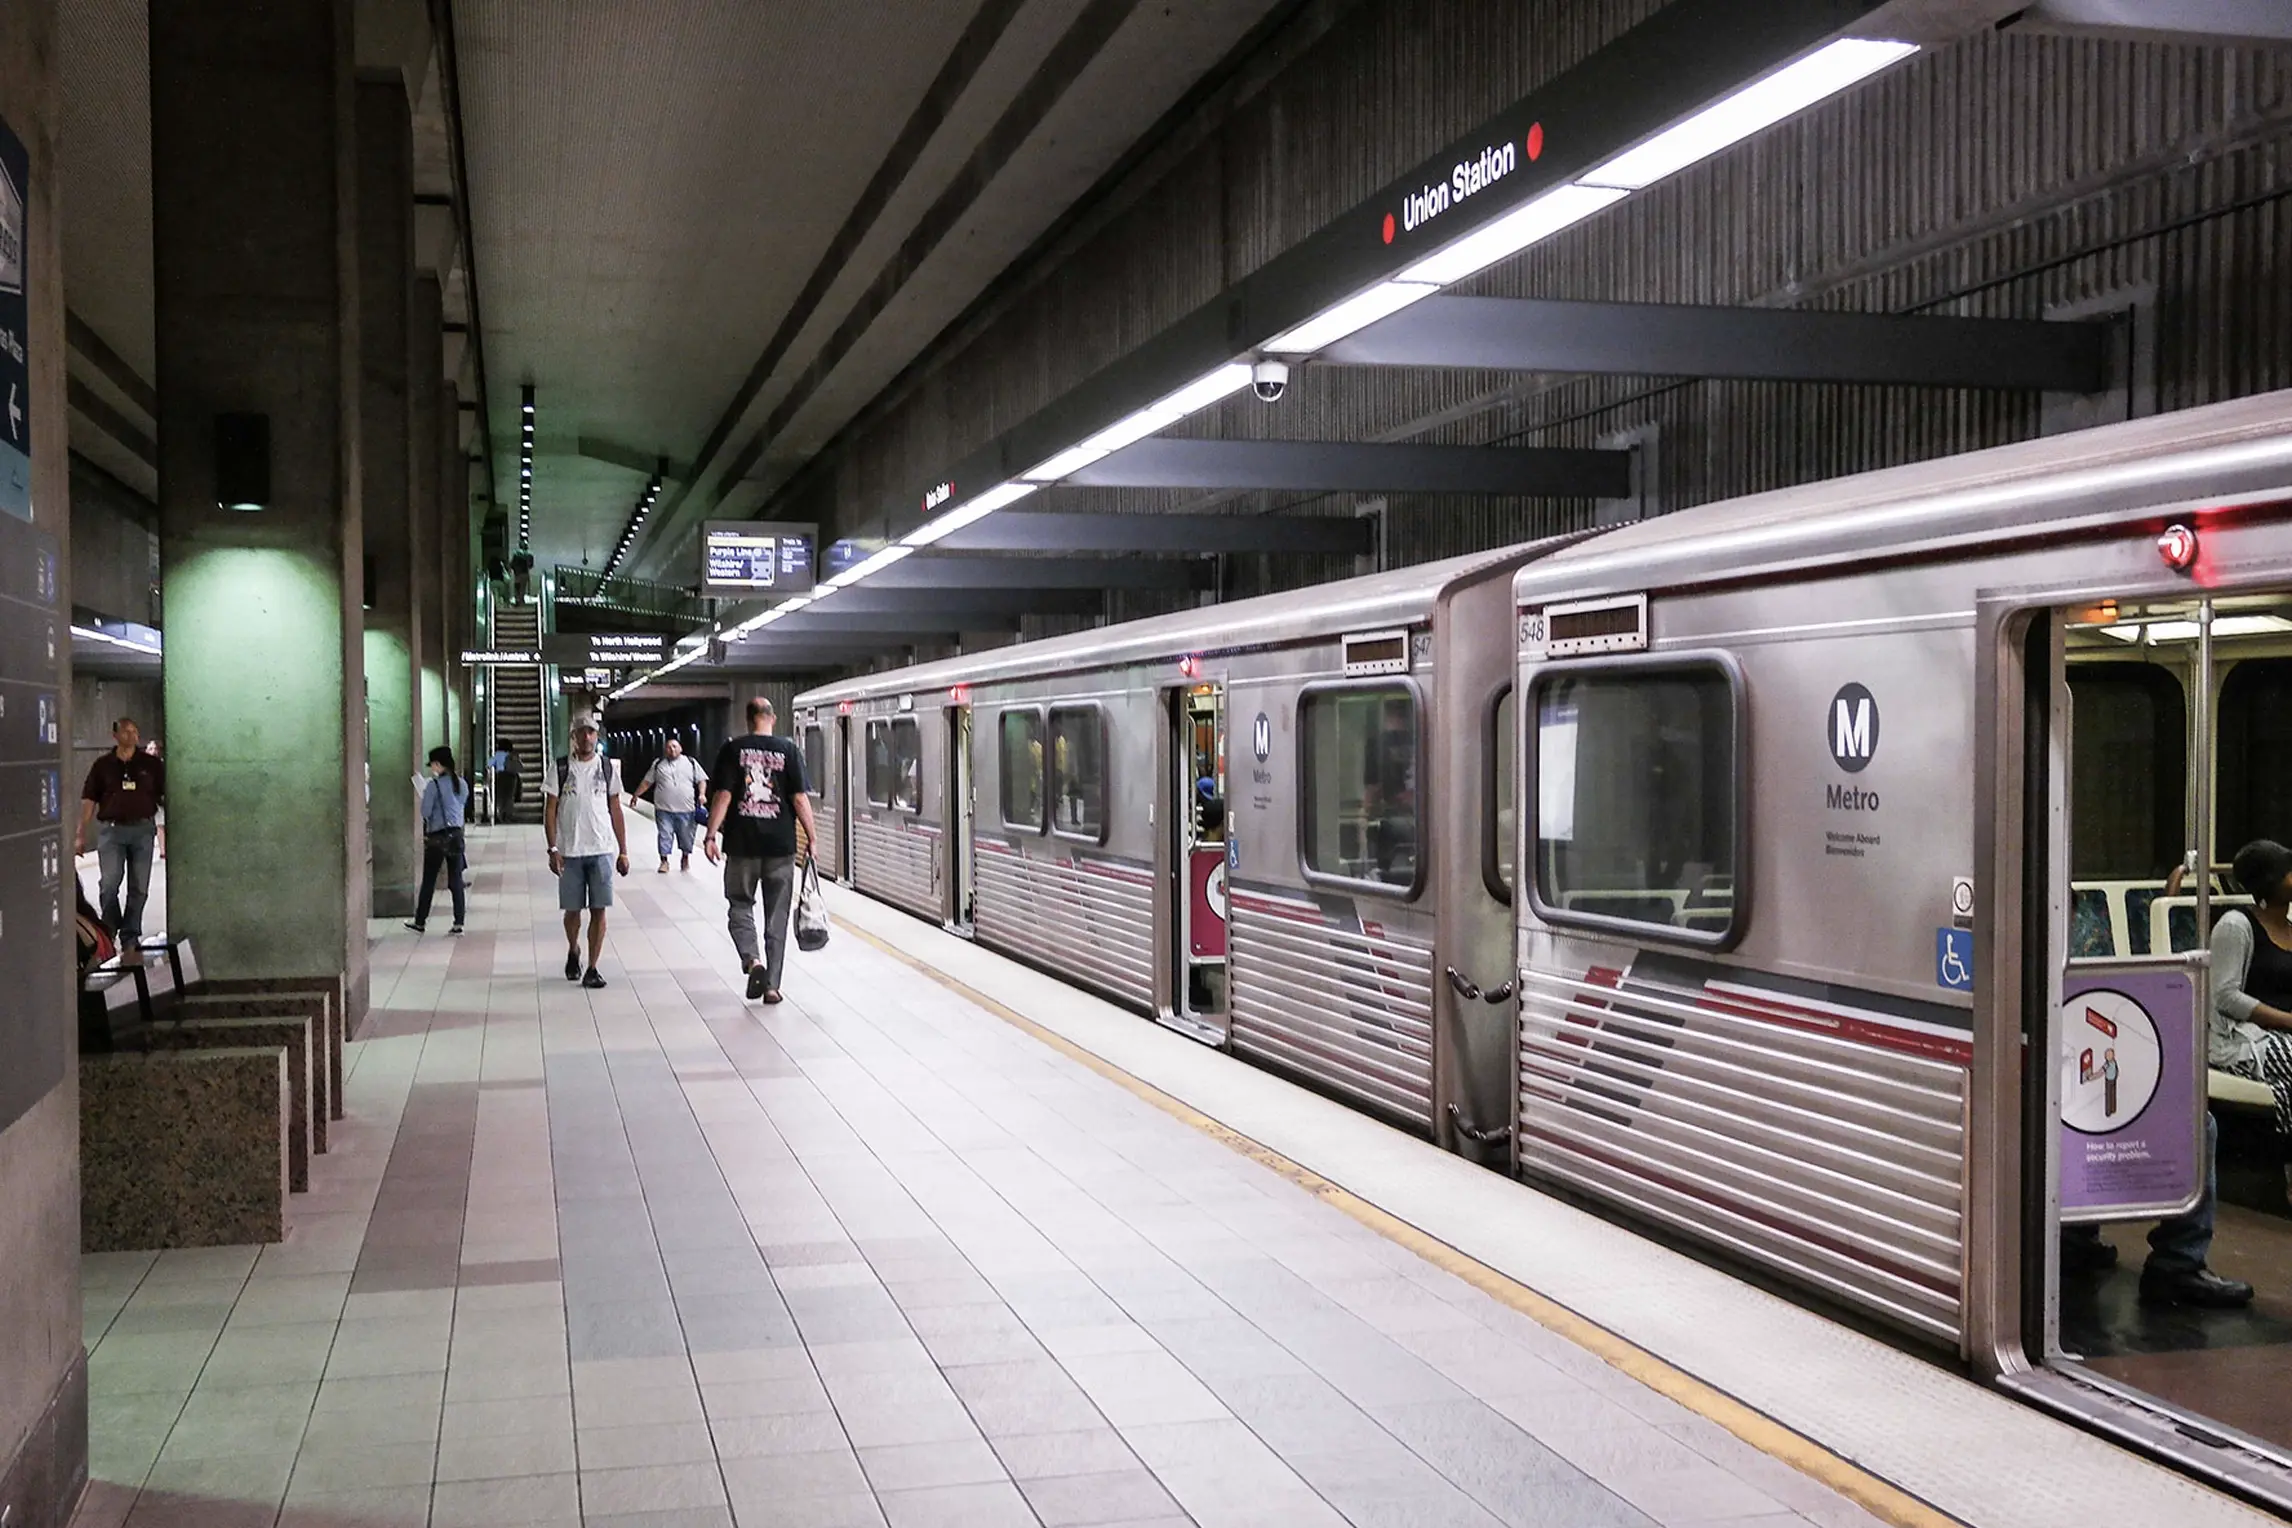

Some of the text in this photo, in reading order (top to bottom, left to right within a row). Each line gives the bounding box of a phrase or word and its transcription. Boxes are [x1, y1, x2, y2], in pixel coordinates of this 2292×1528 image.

[1403, 141, 1516, 232] Union Station
[709, 547, 735, 559] Purple
[736, 547, 753, 557] Line
[1520, 620, 1544, 643] 548
[590, 636, 662, 648] To North Hollywood
[589, 651, 600, 662] To
[1836, 698, 1871, 758] M
[1256, 720, 1269, 755] M
[1253, 768, 1272, 784] Metro
[1827, 783, 1880, 813] Metro
[1825, 830, 1881, 846] Welcome Aboard
[2086, 1141, 2105, 1151] How
[2105, 1140, 2115, 1150] to
[2116, 1140, 2140, 1151] report
[2086, 1151, 2116, 1163] security
